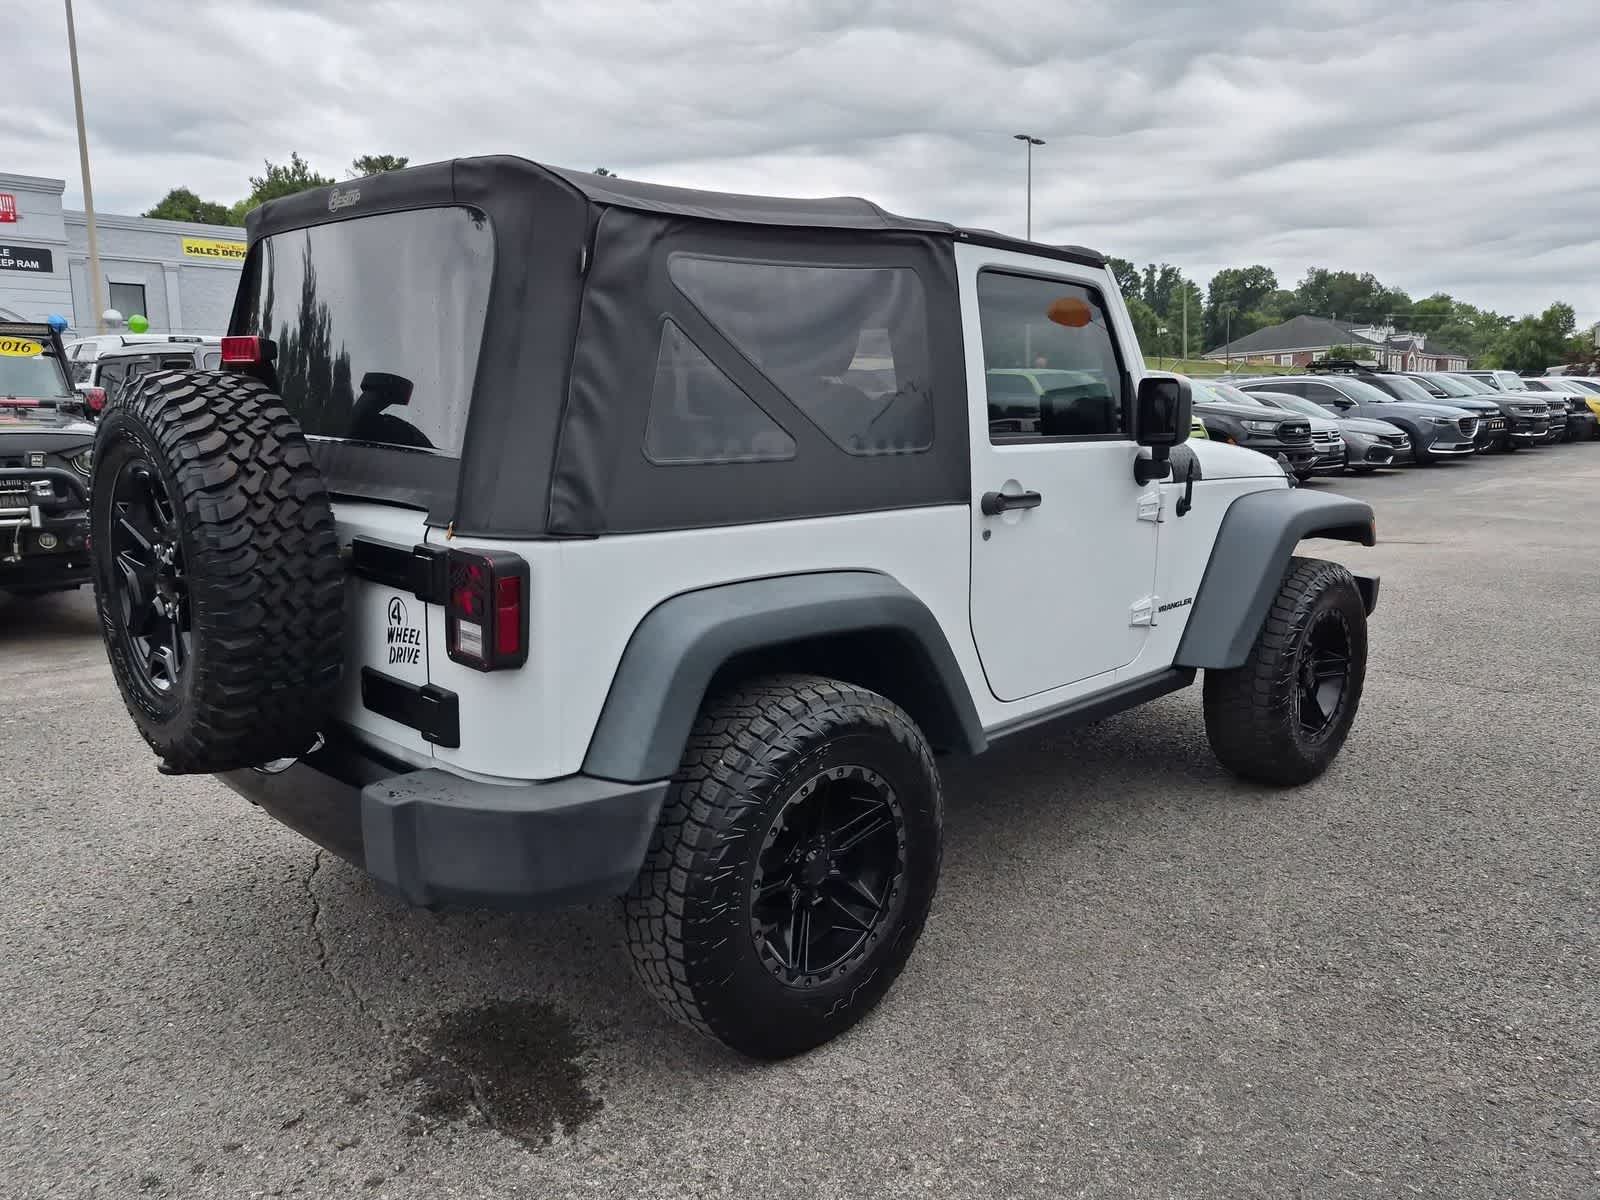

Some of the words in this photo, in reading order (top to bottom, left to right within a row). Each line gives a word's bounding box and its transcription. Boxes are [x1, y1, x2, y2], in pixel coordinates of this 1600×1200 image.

[186, 246, 220, 256] SALES
[16, 259, 39, 269] RAM
[0, 340, 31, 353] 016
[1158, 597, 1192, 613] WRANGLER
[387, 626, 421, 646] WHEEL
[389, 646, 421, 665] DRIVE
